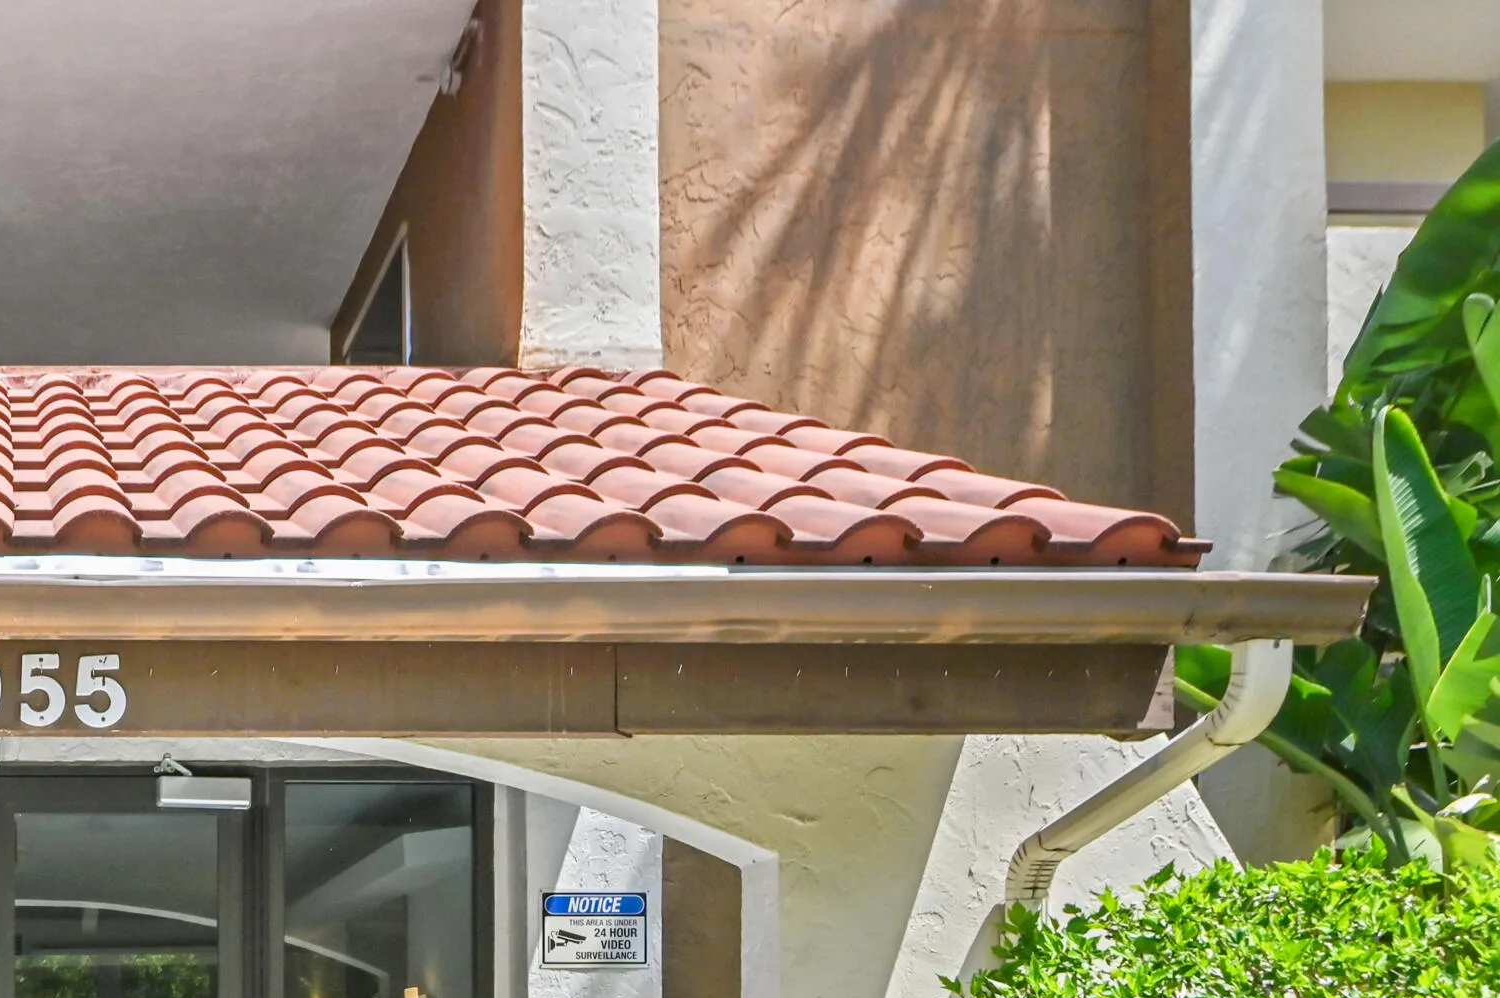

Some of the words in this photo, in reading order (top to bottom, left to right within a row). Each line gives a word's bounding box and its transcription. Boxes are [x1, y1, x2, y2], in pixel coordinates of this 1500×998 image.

[567, 896, 622, 913] NOTICE
[594, 928, 606, 937] 24
[609, 928, 637, 937] HOUR
[600, 940, 631, 949] VIDEO
